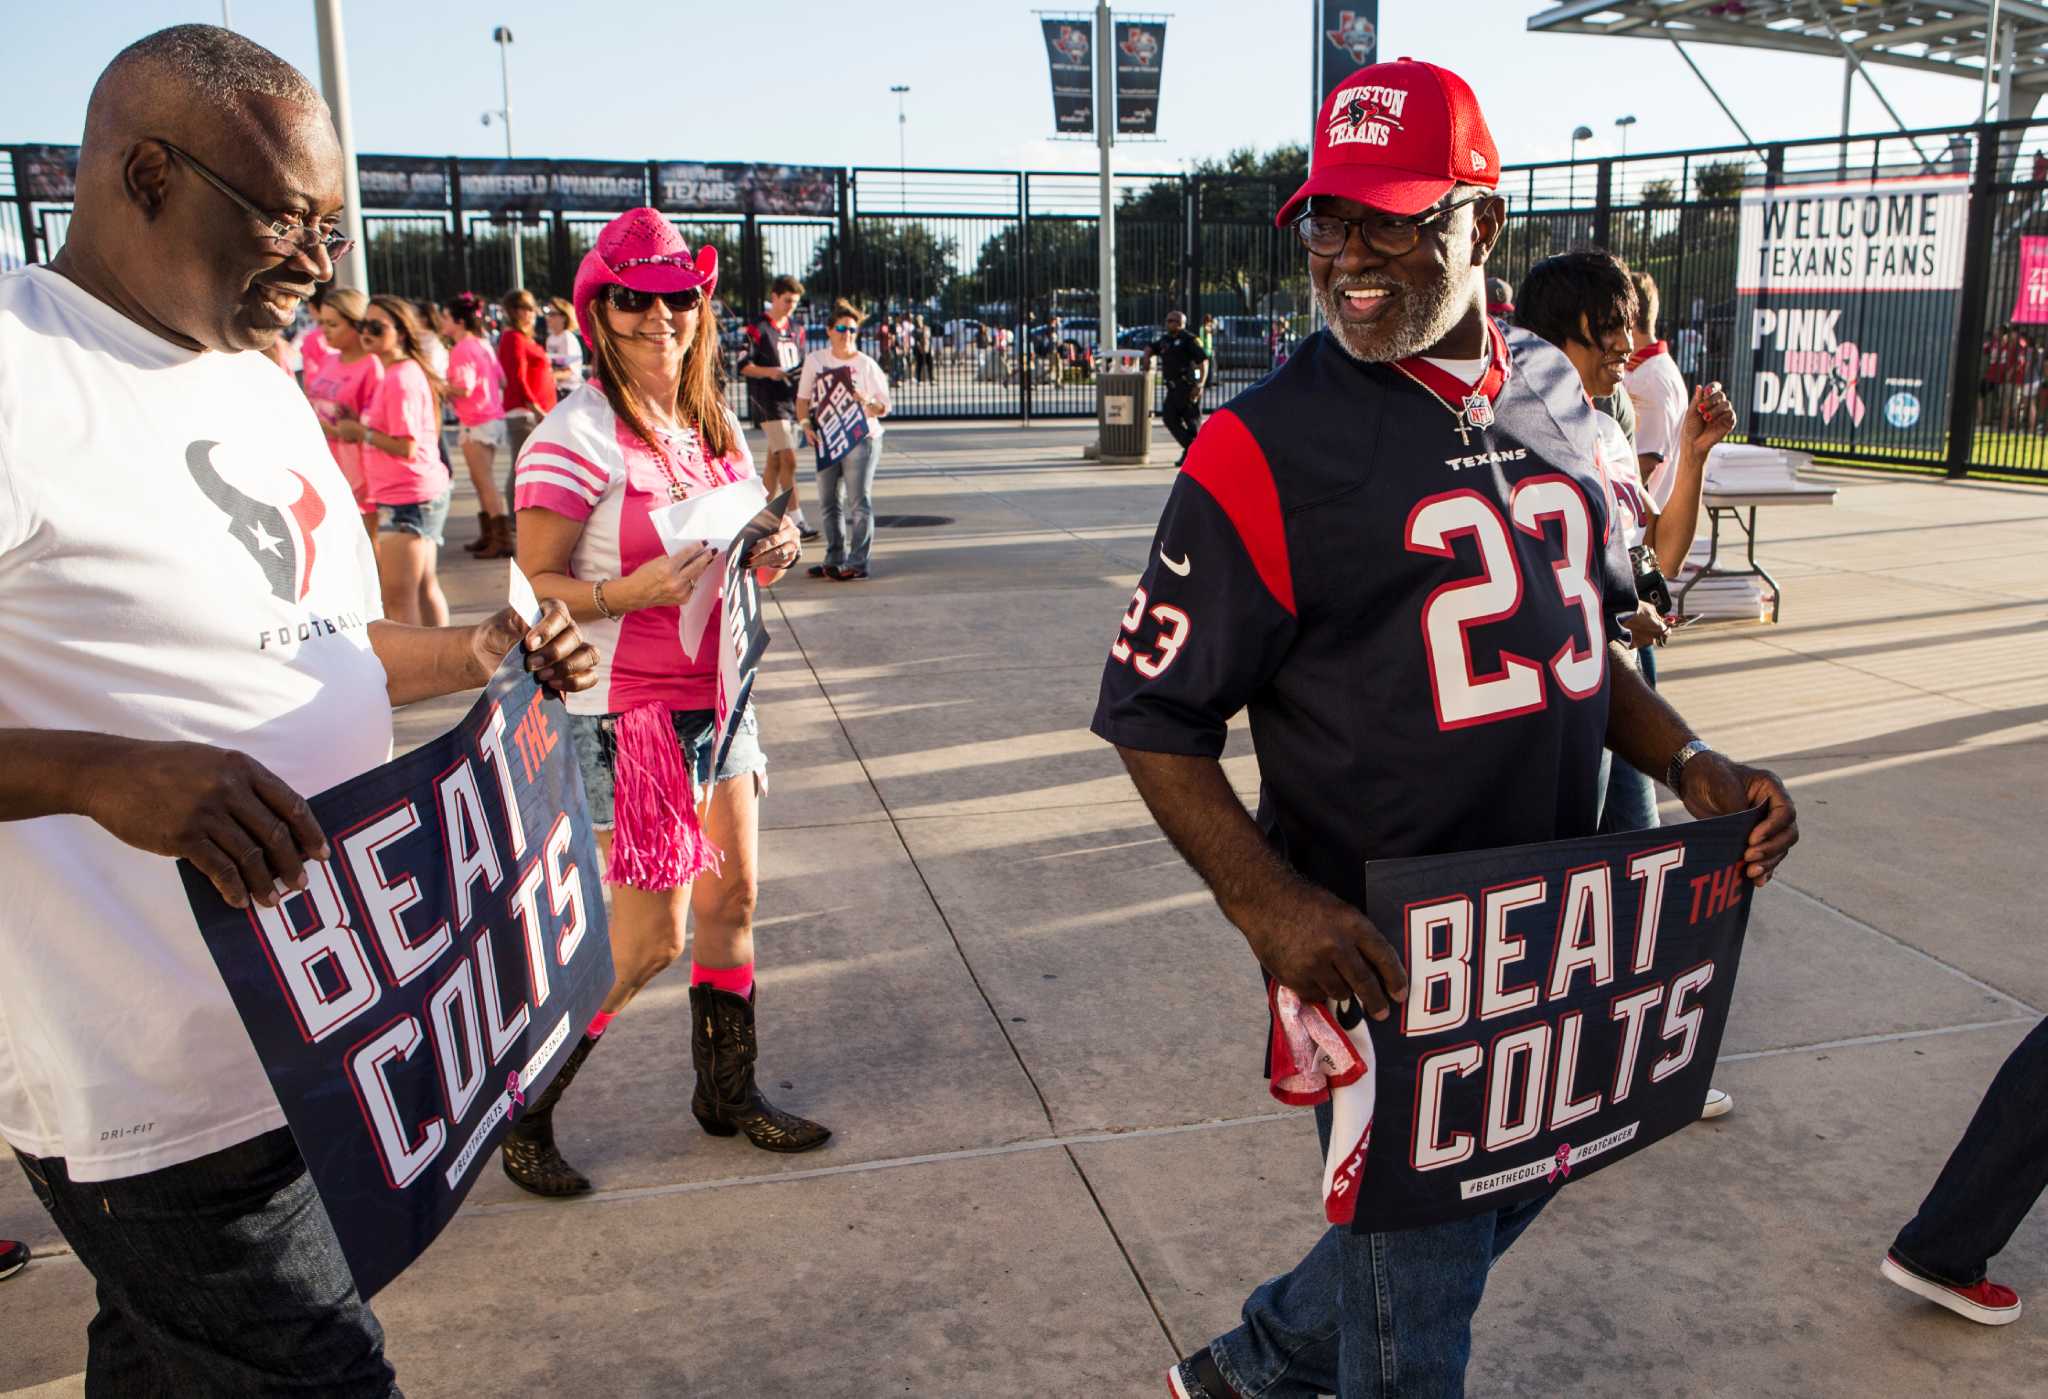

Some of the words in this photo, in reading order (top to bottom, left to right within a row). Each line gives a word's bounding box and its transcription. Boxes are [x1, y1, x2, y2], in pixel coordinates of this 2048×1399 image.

[1329, 85, 1408, 121] HOUSTON
[1327, 122, 1391, 148] TEXANS
[460, 174, 548, 195] HOMEFIELD
[664, 181, 736, 200] TEXANS
[1762, 192, 1939, 241] WELCOME
[1758, 246, 1854, 278] TEXANS
[1866, 244, 1935, 276] FANS
[1751, 308, 1841, 352] PINK
[829, 381, 863, 431] BEAT
[1753, 372, 1827, 417] DAY
[818, 403, 849, 460] COLTS
[1444, 448, 1528, 471] TEXANS
[1405, 473, 1604, 731] 23
[259, 612, 363, 650] FOOTBALL
[1111, 585, 1191, 680] 23
[248, 702, 527, 1046] BEAT
[515, 690, 560, 784] THE
[1401, 841, 1685, 1037] BEAT
[1689, 860, 1745, 925] THE
[343, 811, 588, 1189] COLTS
[1409, 959, 1716, 1172] COLTS
[453, 1102, 504, 1181] #BEATTHECOLTS
[525, 1023, 567, 1080] #BEATCANCER
[100, 1122, 156, 1142] DRI-FIT
[1469, 1163, 1546, 1193] #BEATTHECOLTS
[1576, 1127, 1633, 1160] #BEATCANCER
